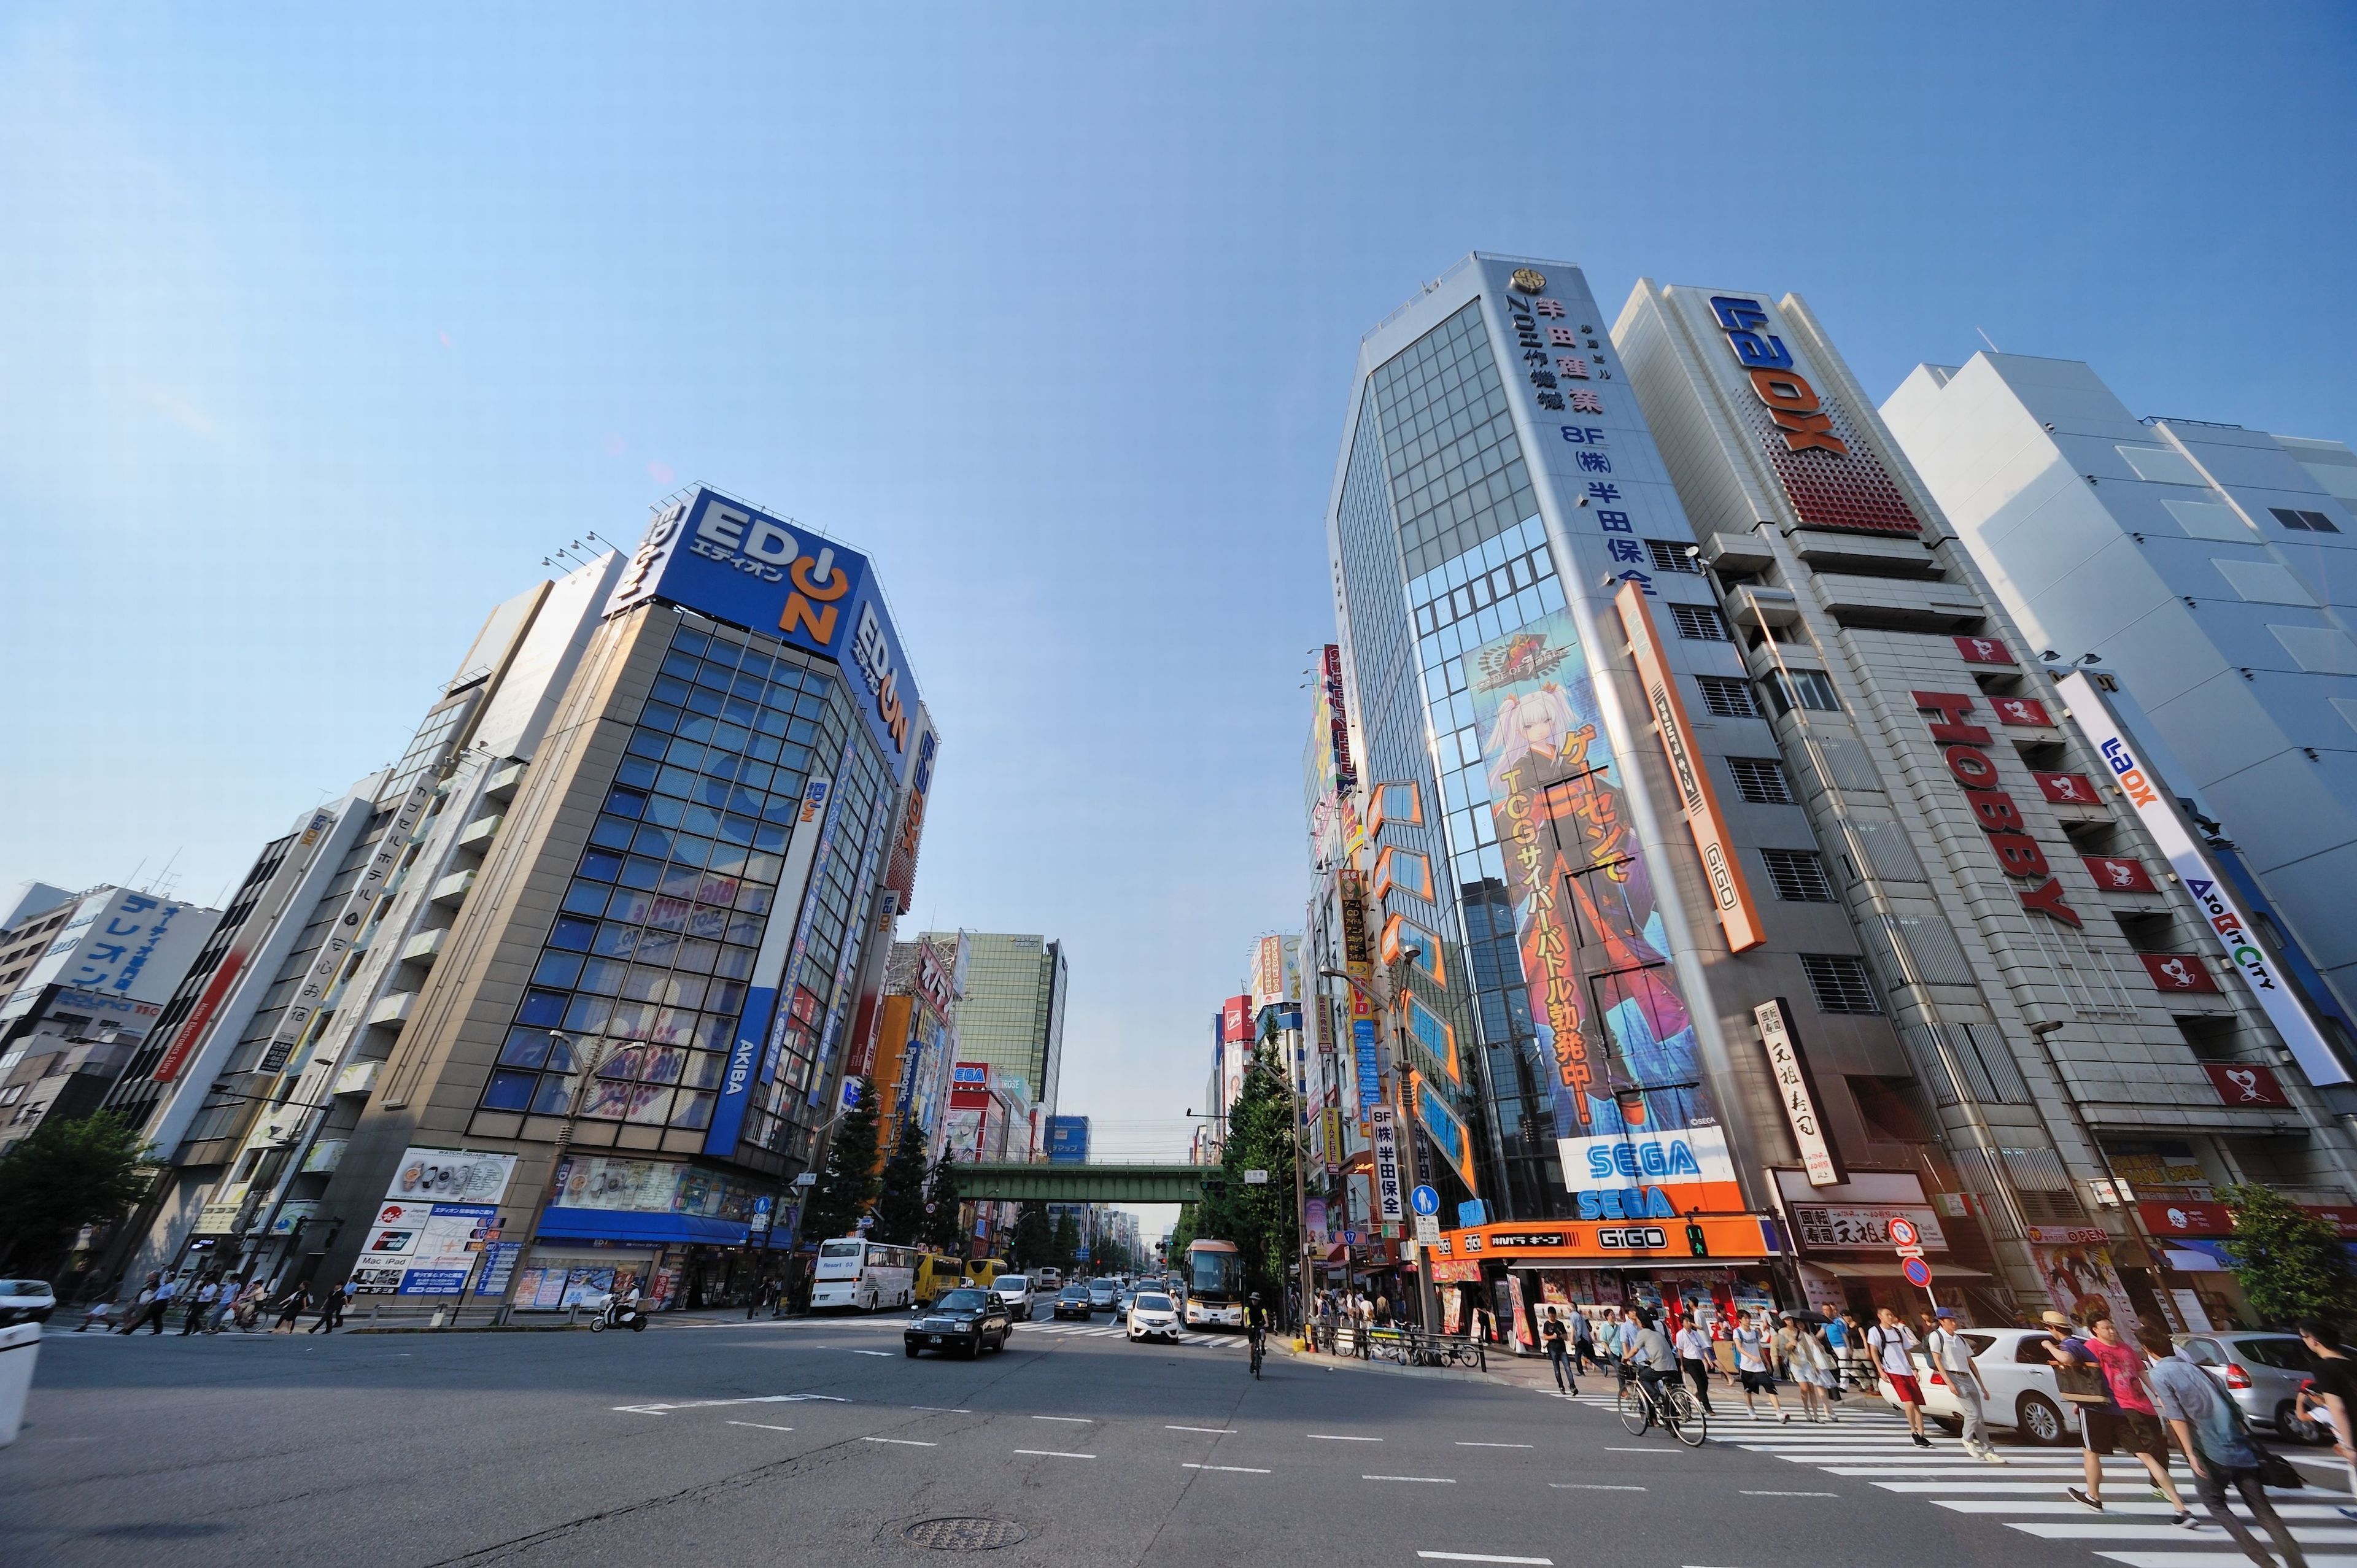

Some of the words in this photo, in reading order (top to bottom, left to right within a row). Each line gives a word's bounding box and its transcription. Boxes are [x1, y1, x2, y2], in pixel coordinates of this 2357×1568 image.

[1535, 297, 1604, 415] 半田産業
[1560, 426, 1606, 445] 8F
[690, 538, 783, 583] エディオン
[696, 500, 849, 645] EDION
[857, 600, 910, 755] EDION
[800, 782, 827, 822] EDION
[1562, 723, 1629, 882] ゲーセンで
[1908, 690, 2084, 929] HOBBY
[358, 786, 427, 900] カプセルホテル
[72, 894, 158, 985] テレオン
[794, 937, 807, 955] 1F
[1271, 937, 1279, 977] WELCOME
[290, 937, 347, 1023] 安心お宿
[1264, 942, 1273, 994] AKIHABARA
[1273, 978, 1279, 992] TO
[192, 1002, 209, 1021] Home
[1352, 977, 1369, 1016] DVD
[170, 1021, 198, 1055] Electronics
[159, 1055, 177, 1074] Store
[726, 1038, 755, 1095] AKIBA
[899, 1047, 917, 1102] Panasonic
[954, 1067, 986, 1084] EGA
[1772, 1041, 1814, 1137] 元祖寿司
[890, 1109, 905, 1157] ONODEN
[1374, 1111, 1391, 1122] 8F
[1376, 1126, 1400, 1215] (株)半田保全
[1587, 1139, 1703, 1179] SEGA
[2165, 1164, 2206, 1182] OPEN
[1577, 1186, 1676, 1219] SEGA
[1799, 1210, 1827, 1226] 回転
[1596, 1227, 1668, 1249] GiGO
[1805, 1227, 1835, 1243] 寿司
[2067, 1229, 2108, 1242] OPEN
[385, 1257, 407, 1266] iPad
[565, 1294, 582, 1303] 220
[655, 1276, 668, 1295] 免税
